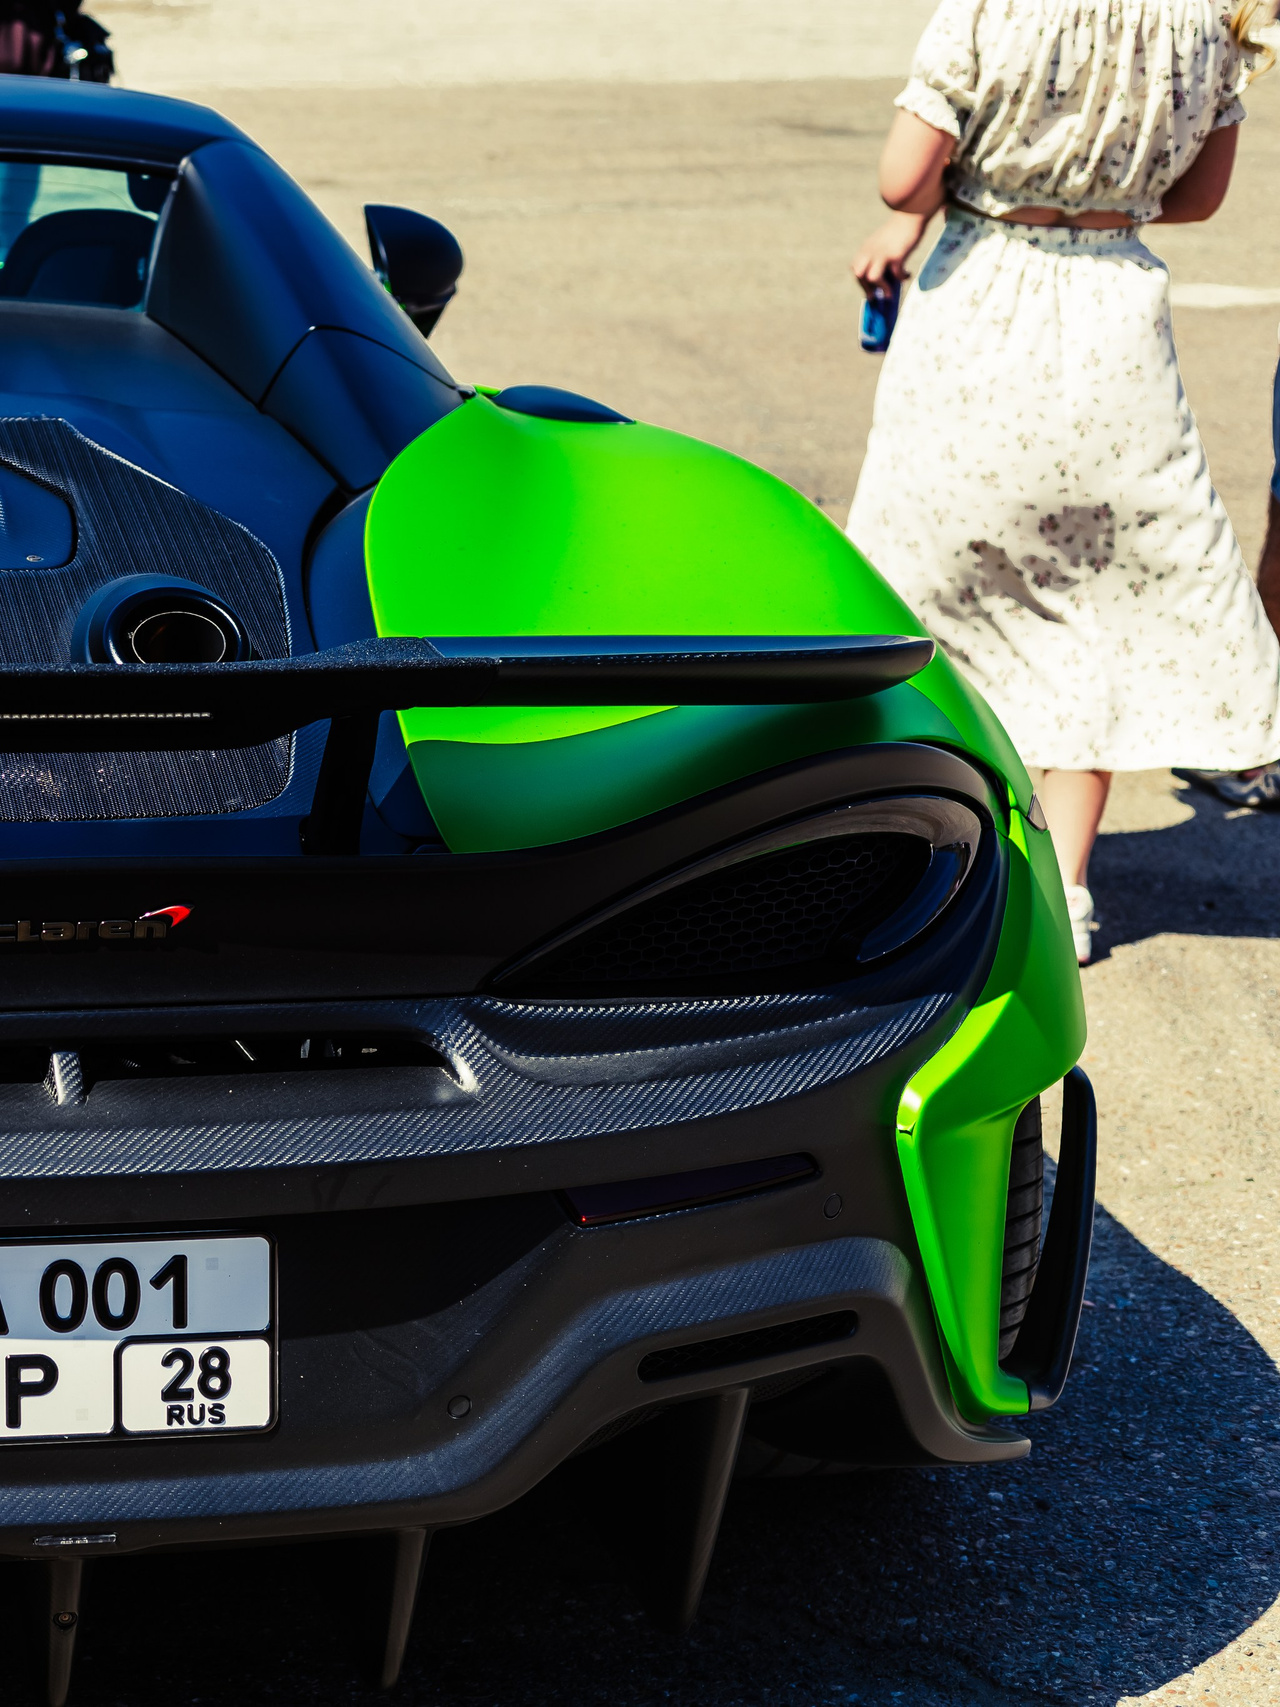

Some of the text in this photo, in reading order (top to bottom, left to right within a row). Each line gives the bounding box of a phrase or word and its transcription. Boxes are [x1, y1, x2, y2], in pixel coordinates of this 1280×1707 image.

[39, 1254, 188, 1333] 001
[161, 1346, 232, 1402] 28
[166, 1404, 227, 1426] RUS
